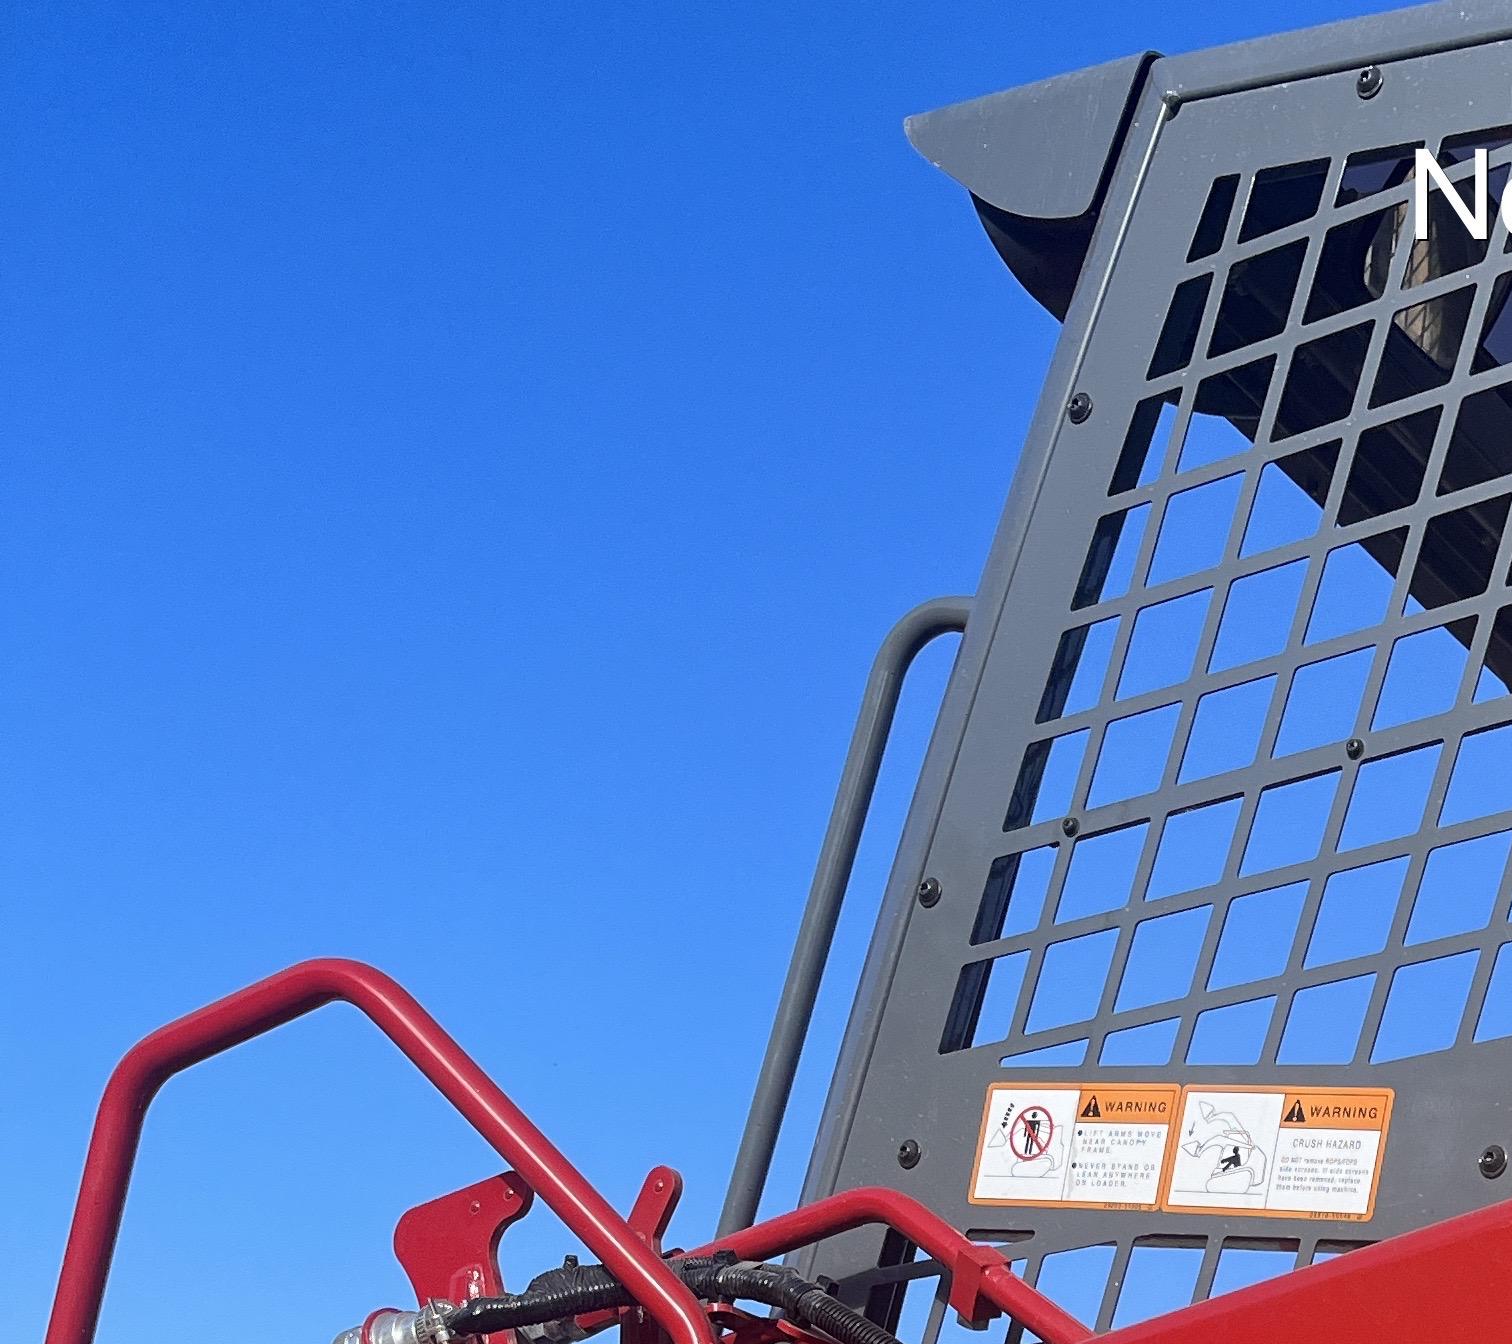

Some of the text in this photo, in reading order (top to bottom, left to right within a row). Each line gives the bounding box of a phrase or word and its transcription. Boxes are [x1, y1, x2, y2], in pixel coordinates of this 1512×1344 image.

[1104, 1101, 1167, 1112] WARNING
[1309, 1105, 1378, 1119] WARNING
[1292, 1138, 1361, 1149] CRUSH HAZARD
